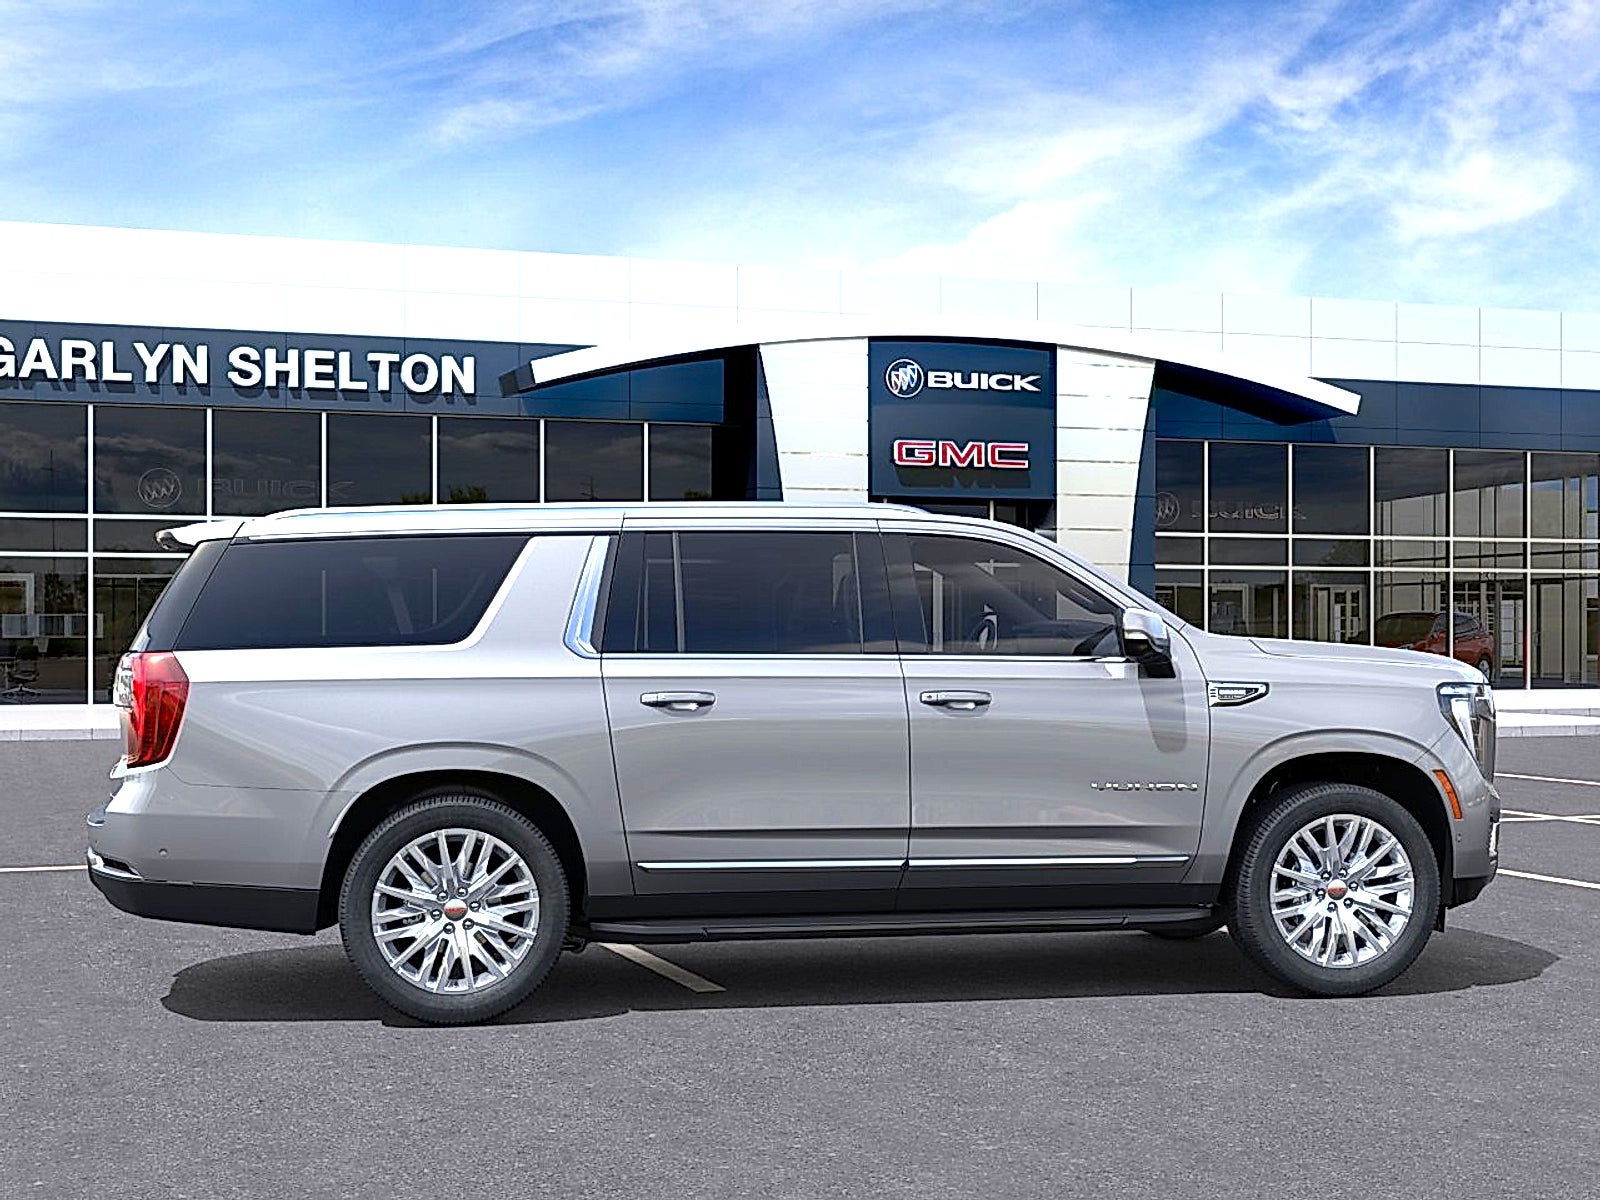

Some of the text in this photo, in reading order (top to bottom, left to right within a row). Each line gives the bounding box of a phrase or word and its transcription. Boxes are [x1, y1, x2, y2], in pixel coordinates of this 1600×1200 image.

[227, 346, 475, 394] SHELTON
[927, 371, 1041, 392] BUICK
[893, 439, 1029, 468] GMC
[1090, 781, 1198, 792] YUKON
